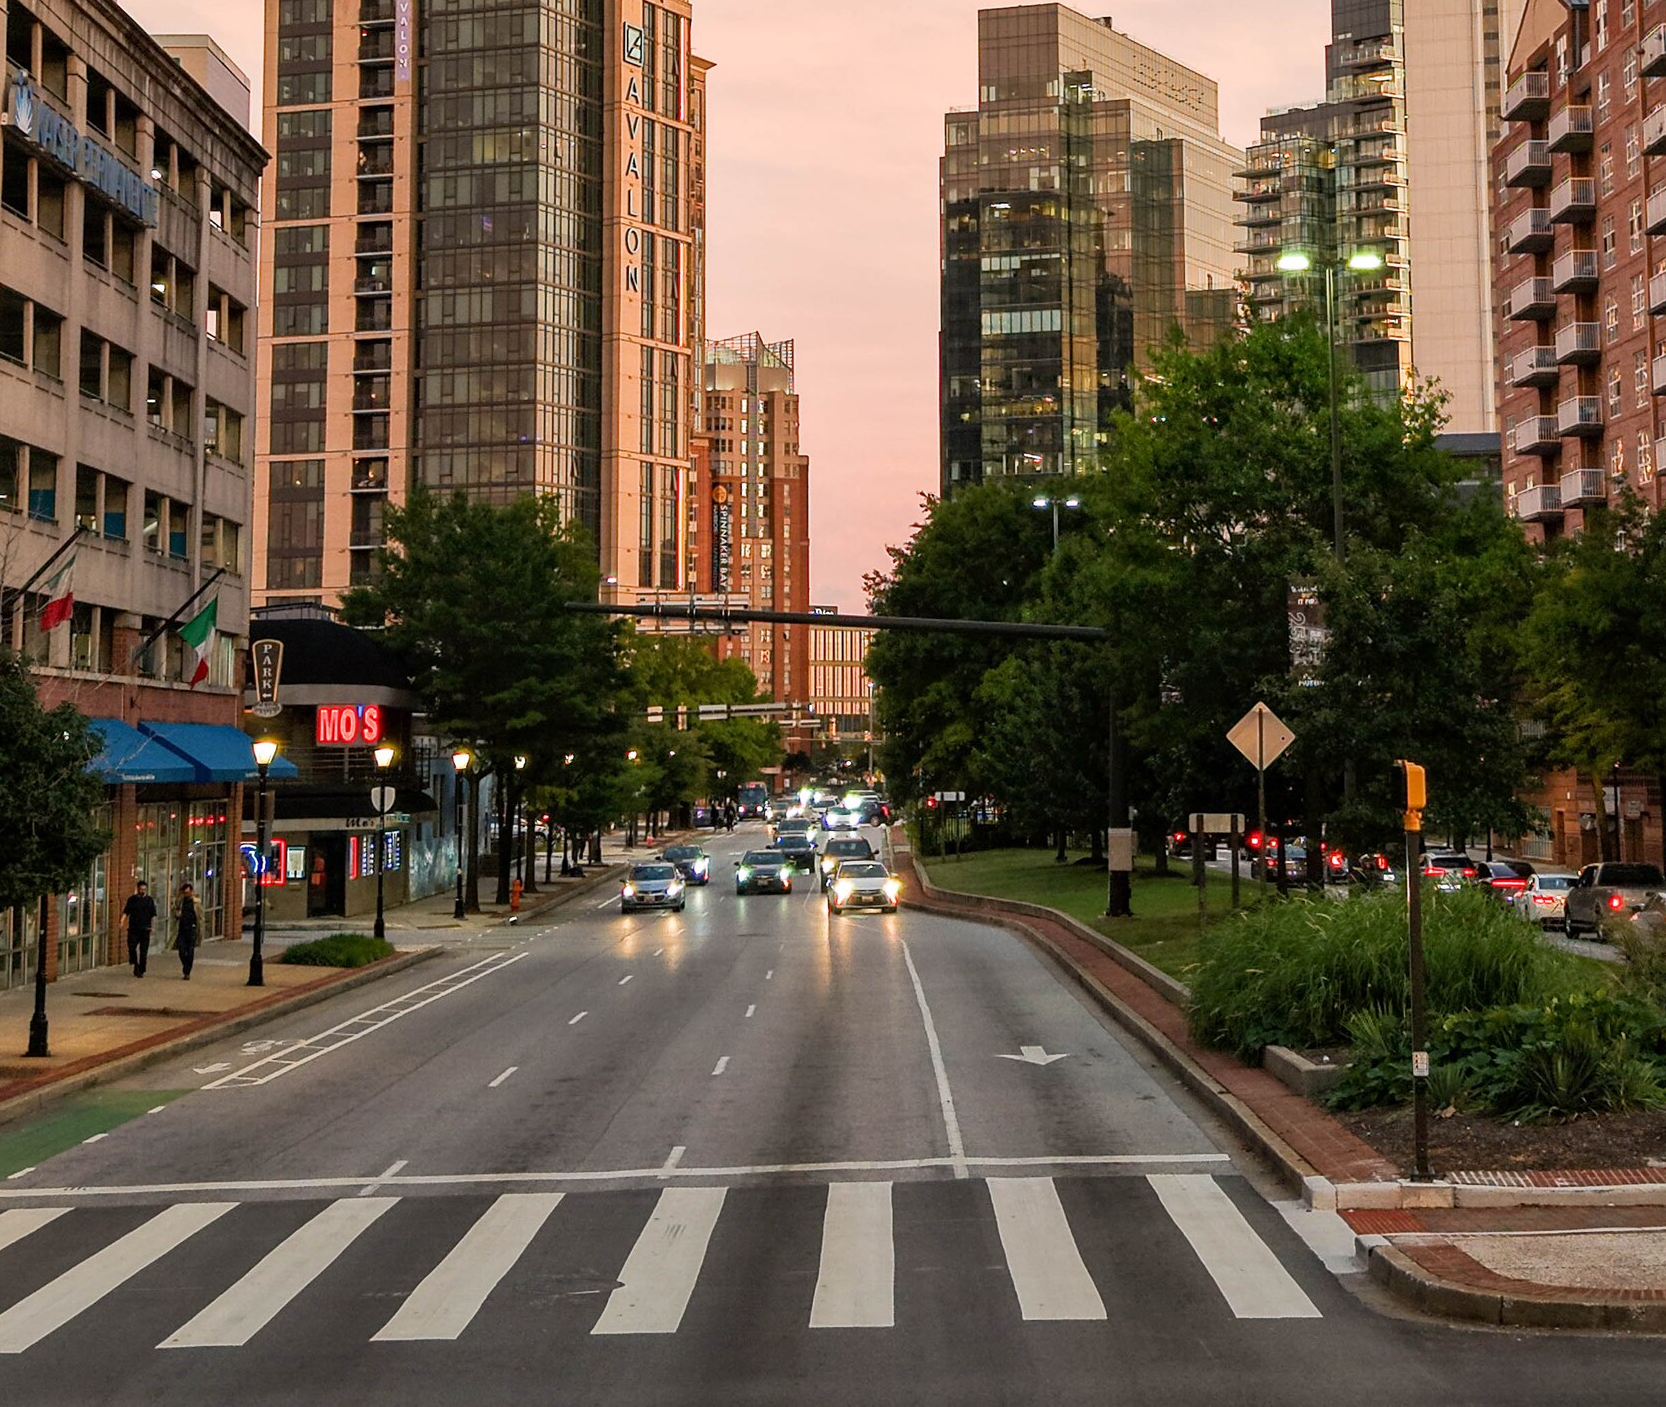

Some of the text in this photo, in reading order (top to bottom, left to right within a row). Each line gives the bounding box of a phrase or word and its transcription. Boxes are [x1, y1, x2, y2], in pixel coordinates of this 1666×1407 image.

[38, 102, 158, 229] KAISER PERMANENTE
[625, 76, 640, 293] AVALON
[719, 504, 728, 587] SPINNAKER BAY
[262, 644, 273, 690] PARK
[318, 705, 380, 744] MO'S
